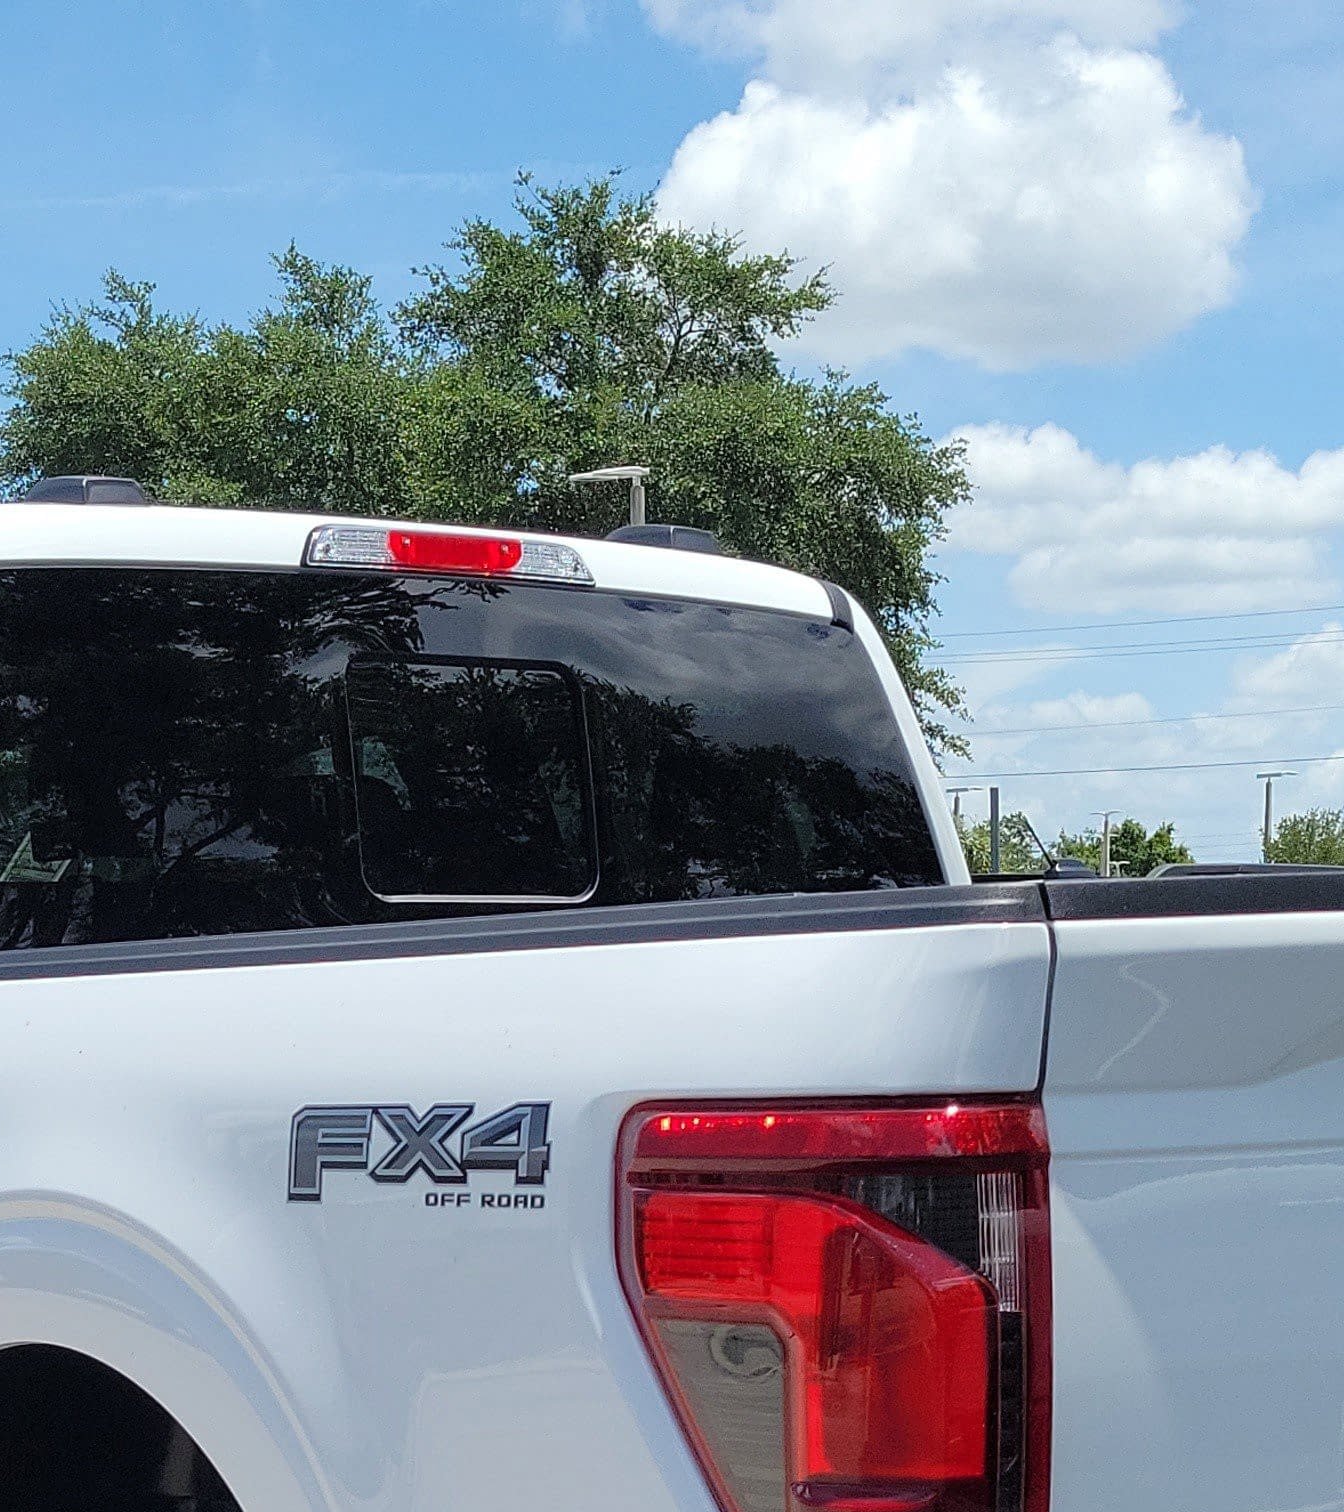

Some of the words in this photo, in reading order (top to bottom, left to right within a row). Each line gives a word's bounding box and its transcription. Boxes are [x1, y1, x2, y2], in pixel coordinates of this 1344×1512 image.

[287, 1100, 553, 1203] FX4
[424, 1192, 471, 1208] OFF
[480, 1193, 545, 1209] ROAD
